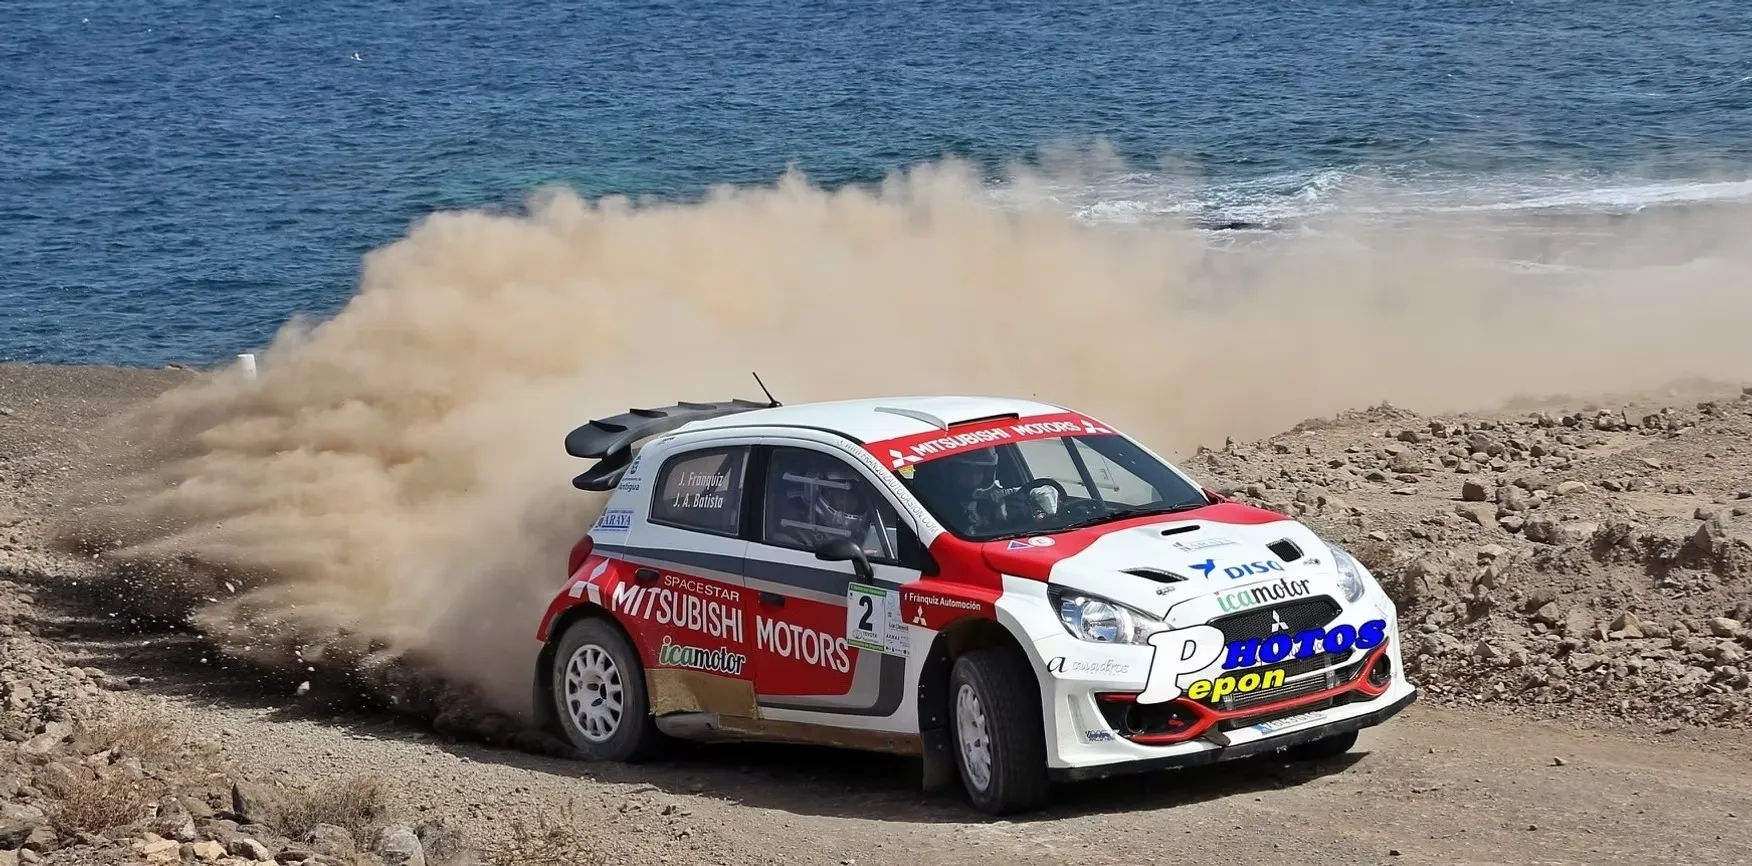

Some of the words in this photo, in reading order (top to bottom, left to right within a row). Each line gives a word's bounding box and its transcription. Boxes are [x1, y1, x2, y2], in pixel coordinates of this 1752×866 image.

[908, 428, 1010, 457] MITSUBISHI
[1010, 421, 1082, 436] MOTORS
[678, 472, 686, 486] J.
[673, 493, 680, 507] J.
[682, 494, 692, 508] A.
[693, 493, 724, 509] Batista
[602, 514, 631, 526] ARAYA
[939, 597, 982, 611] Automoción
[1213, 577, 1311, 613] icamotor
[611, 581, 744, 644] MITSUBISHI
[755, 615, 851, 674] MOTORS
[858, 595, 874, 632] 2
[658, 635, 746, 676] icamotor
